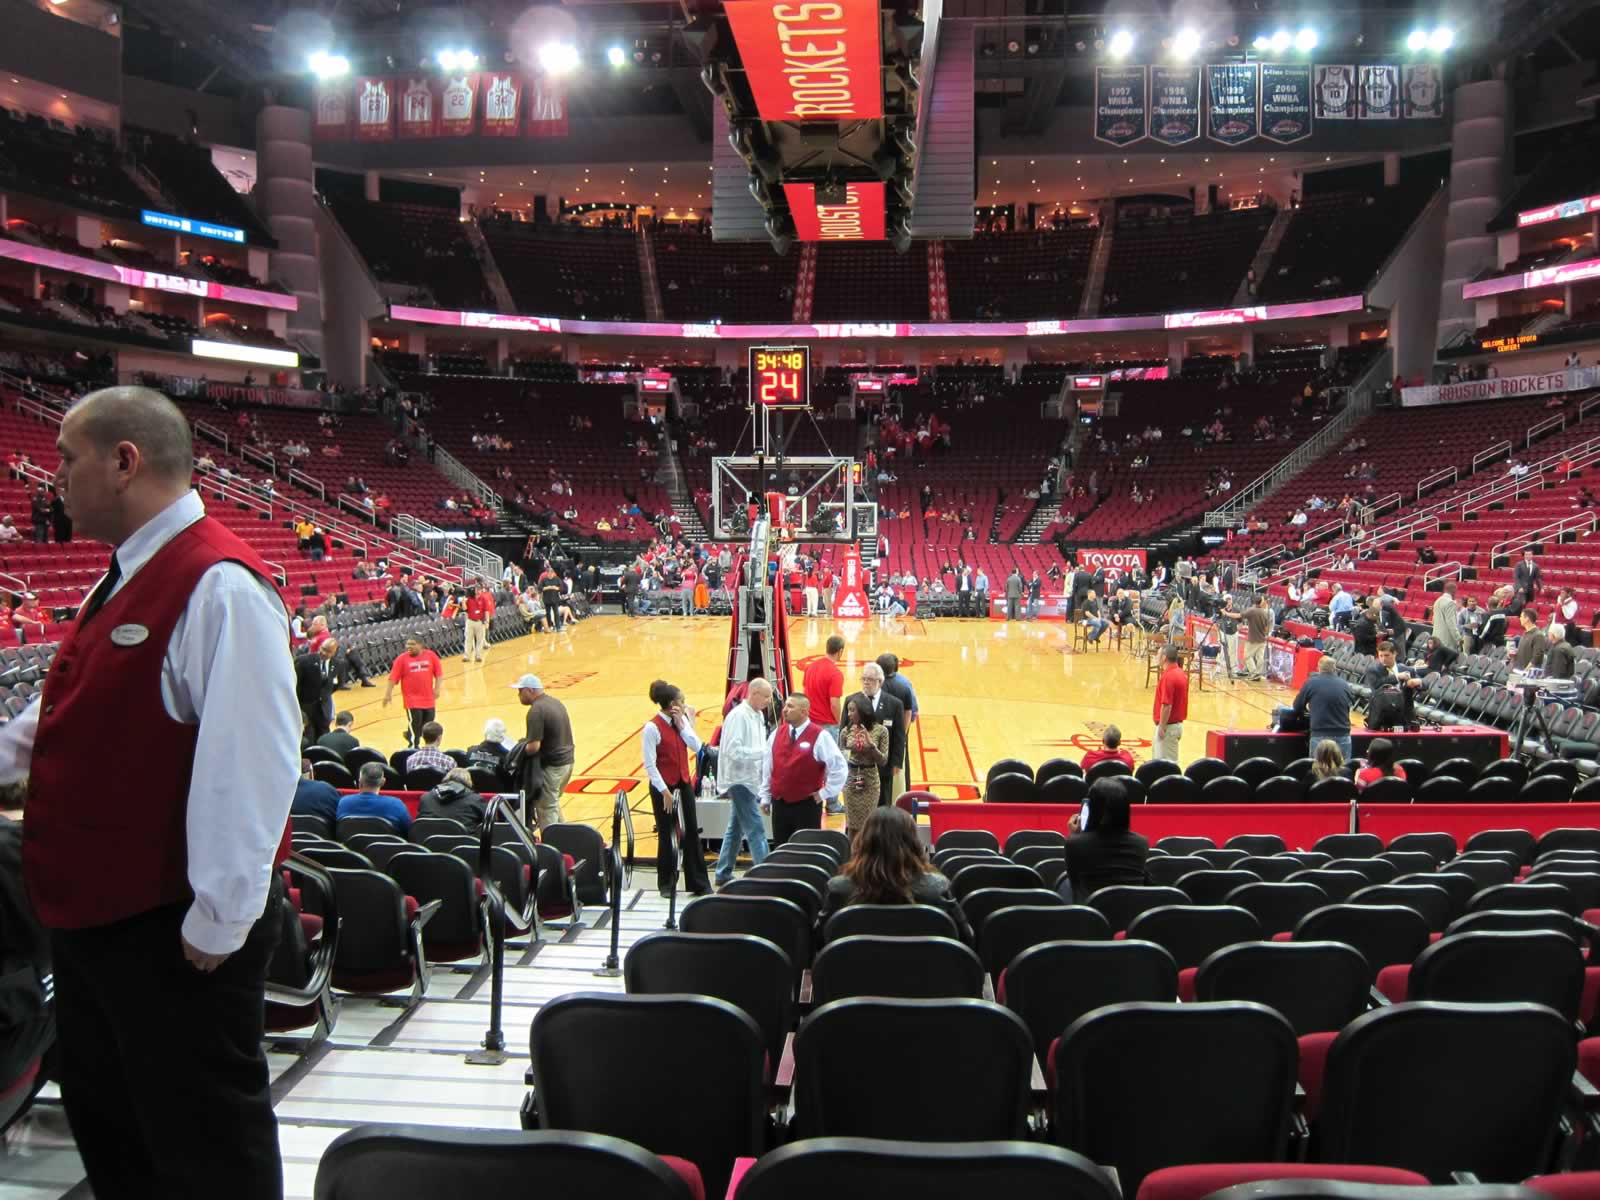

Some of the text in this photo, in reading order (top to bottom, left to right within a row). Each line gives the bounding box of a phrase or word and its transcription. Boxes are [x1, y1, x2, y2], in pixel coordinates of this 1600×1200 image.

[773, 2, 856, 117] ROCKETS
[1108, 97, 1133, 105] WNBA
[1161, 97, 1188, 105] WNBA
[1219, 96, 1246, 104] WNBA
[1272, 94, 1299, 103] WNBA
[1099, 107, 1143, 116] Champions
[1153, 107, 1197, 116] Champions
[1210, 106, 1255, 115] Champions
[1264, 104, 1308, 114] Champions
[808, 186, 864, 239] HOUST
[144, 215, 234, 238] UNITED UNITED
[757, 353, 802, 370] 34:48
[761, 372, 798, 400] 24
[1439, 374, 1564, 401] HOUSTON ROCKETS
[1083, 554, 1140, 567] TOYOTA
[838, 606, 864, 616] PEAK
